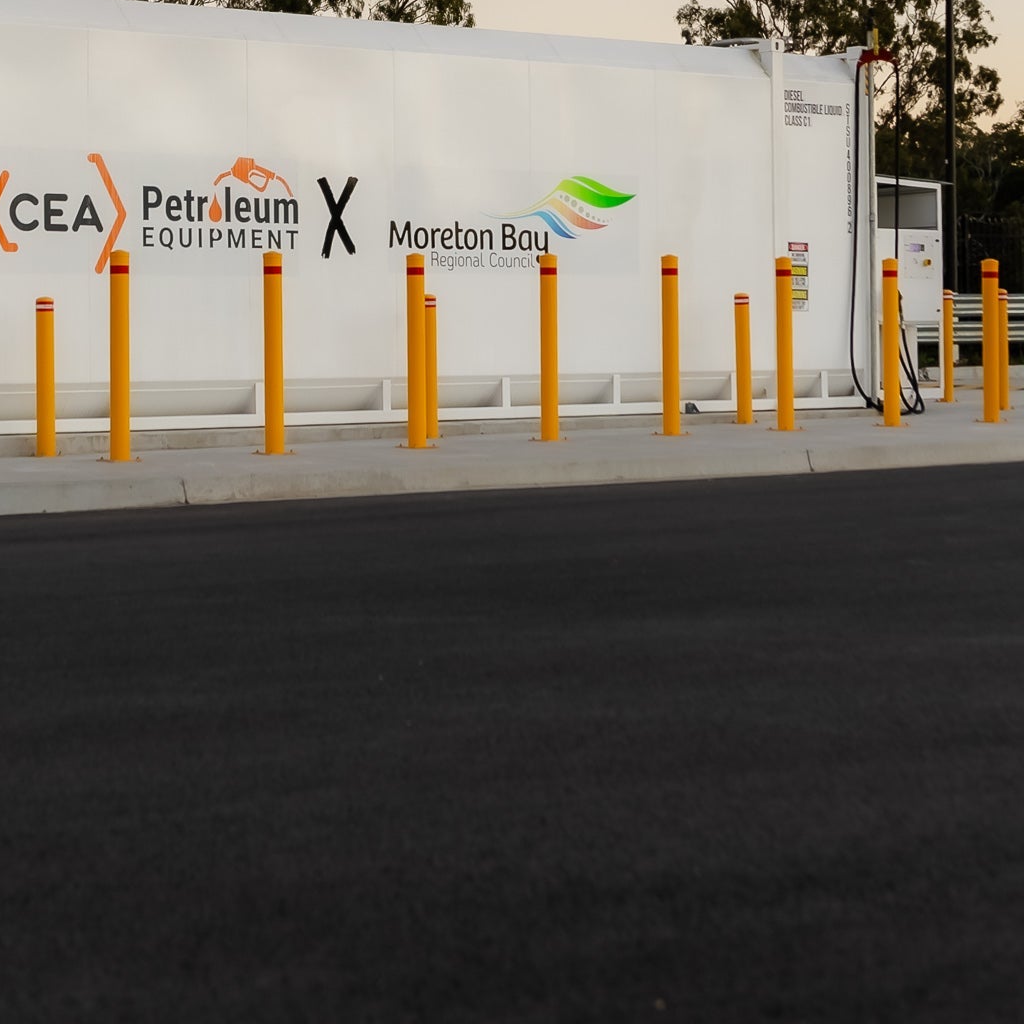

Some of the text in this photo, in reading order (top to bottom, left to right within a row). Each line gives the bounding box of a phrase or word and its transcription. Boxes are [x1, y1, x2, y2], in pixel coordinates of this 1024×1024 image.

[784, 90, 803, 101] DIESEL
[784, 102, 842, 115] COMBUSTIBLE LIQUID
[784, 115, 802, 126] CLASS
[317, 176, 359, 259] X
[142, 226, 299, 250] EQUIPMENT
[389, 220, 549, 264] Moreton Bay
[430, 251, 535, 271] Regional Council
